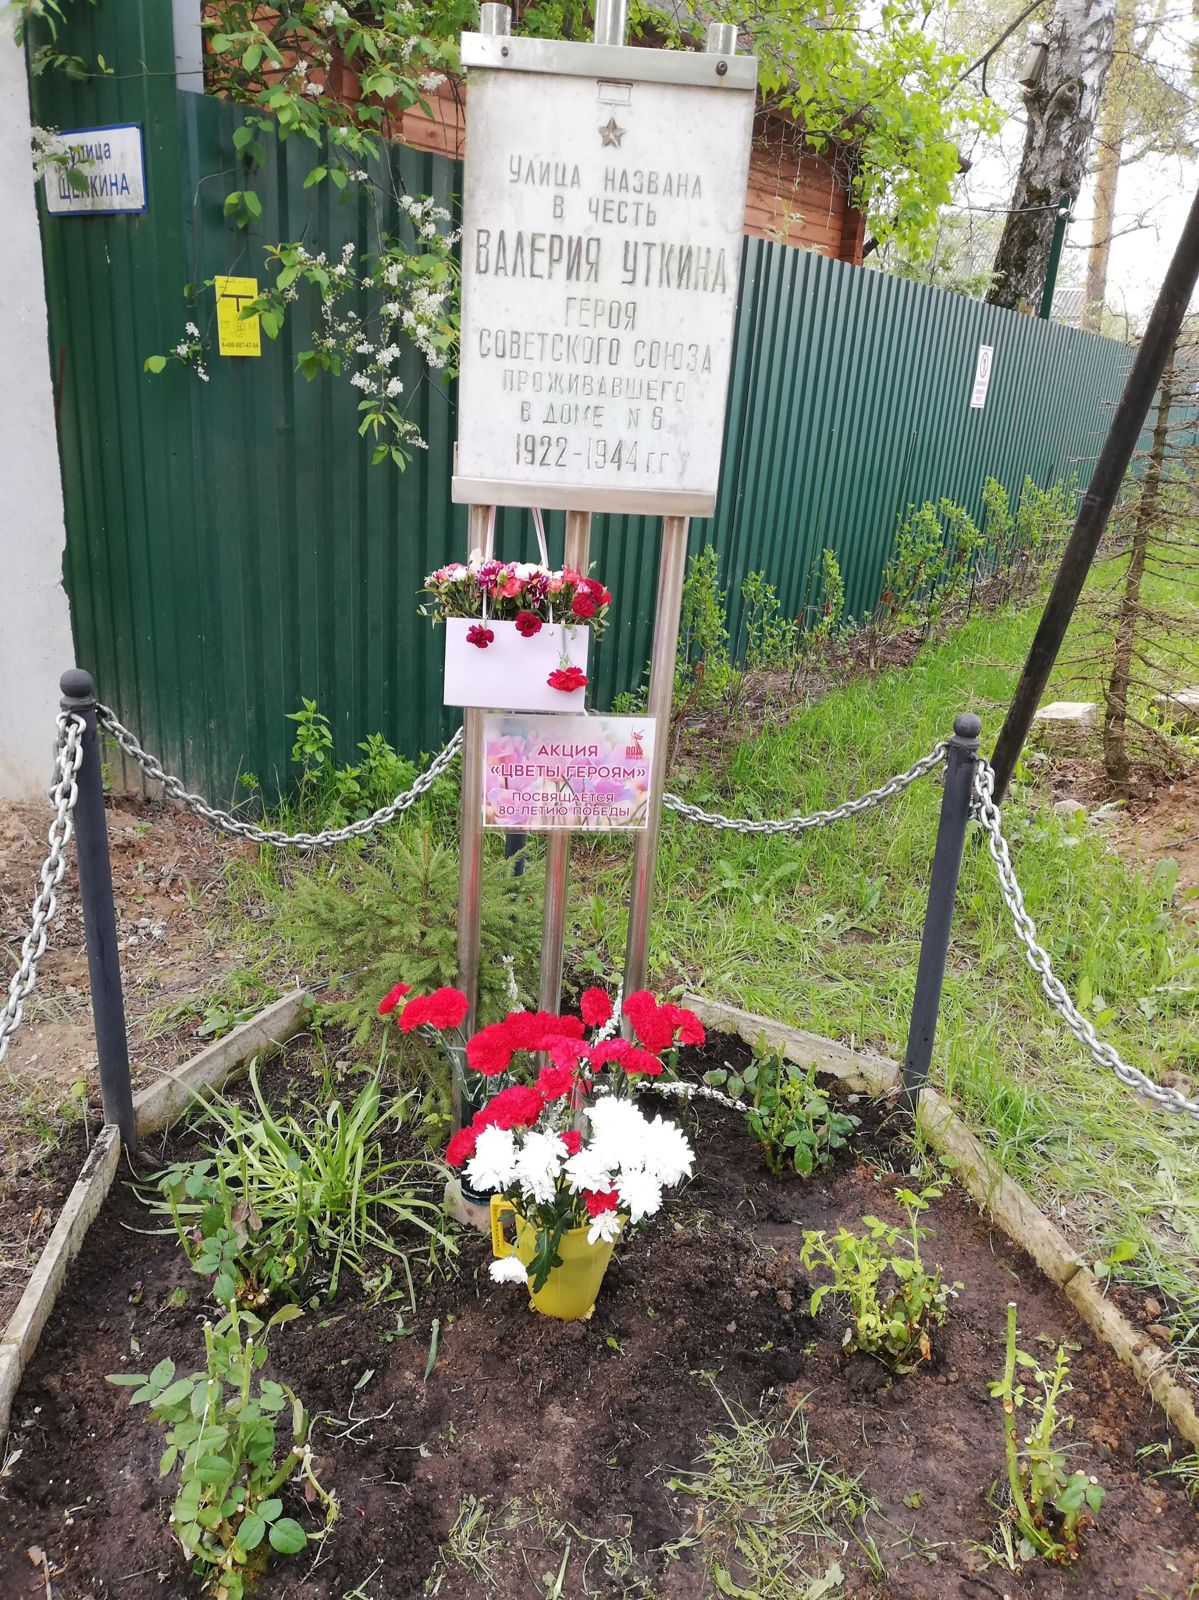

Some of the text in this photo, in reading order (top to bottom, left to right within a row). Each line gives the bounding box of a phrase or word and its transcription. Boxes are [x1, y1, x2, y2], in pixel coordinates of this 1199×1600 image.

[58, 173, 130, 203] ЩКИНА
[508, 154, 702, 199] УЛИЦА НАЗВАНА
[553, 195, 656, 227] В ЧЕСТЬ
[475, 228, 727, 294] ВАЛЕРИЯ УТКИНА
[564, 296, 637, 331] ГЕРОЯ
[478, 328, 712, 374] СОВЕТСКОГО СОЮЗА
[502, 369, 686, 403] ПРОЖИВАВШЕГО
[520, 400, 531, 423] В
[542, 402, 605, 428] ДОМЕ
[651, 406, 663, 431] 6
[537, 744, 598, 758] АКЦИЯ
[490, 764, 646, 779] «ЦВЕТЫ ГЕРОЯМ»
[499, 806, 630, 817] 80-ЛЕТИЮ ПОБЕДЫ
[512, 792, 614, 803] ПОСВЯЩАЕТСЯ
